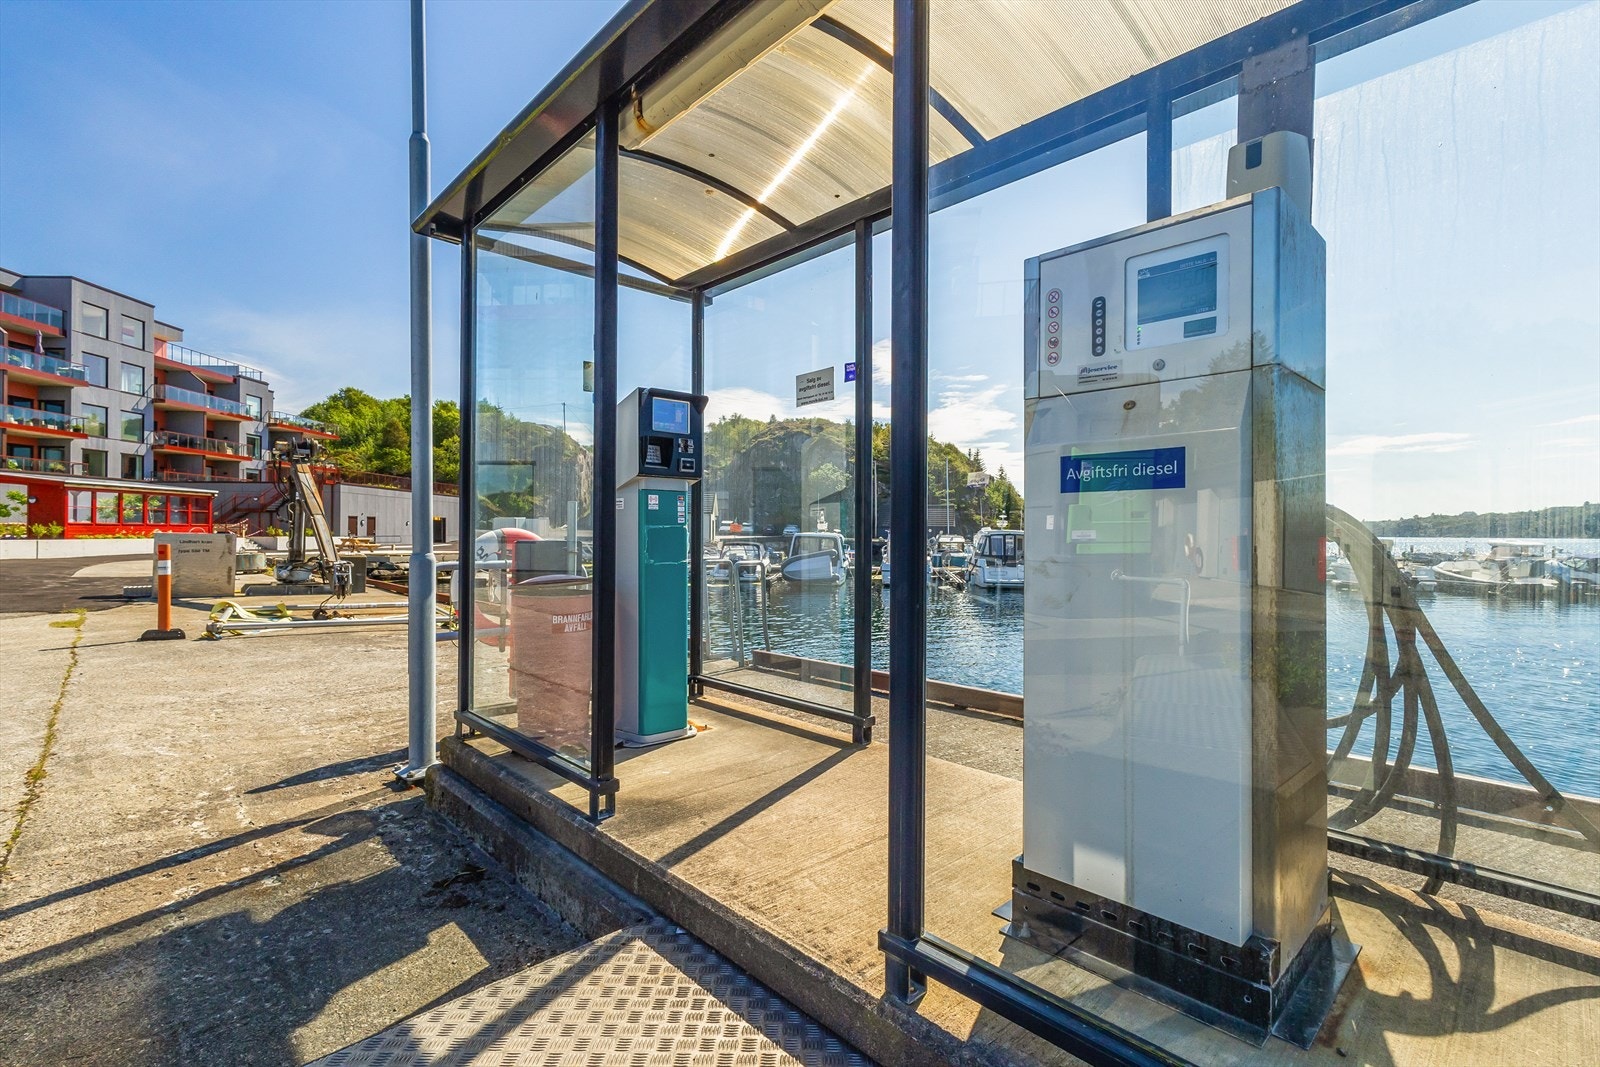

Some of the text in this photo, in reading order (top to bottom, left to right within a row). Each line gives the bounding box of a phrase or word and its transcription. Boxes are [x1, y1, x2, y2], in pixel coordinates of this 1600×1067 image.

[1066, 460, 1178, 482] Avgiftsfri diesel
[552, 612, 592, 624] BRANNFARLI
[564, 621, 587, 633] AVFALL
